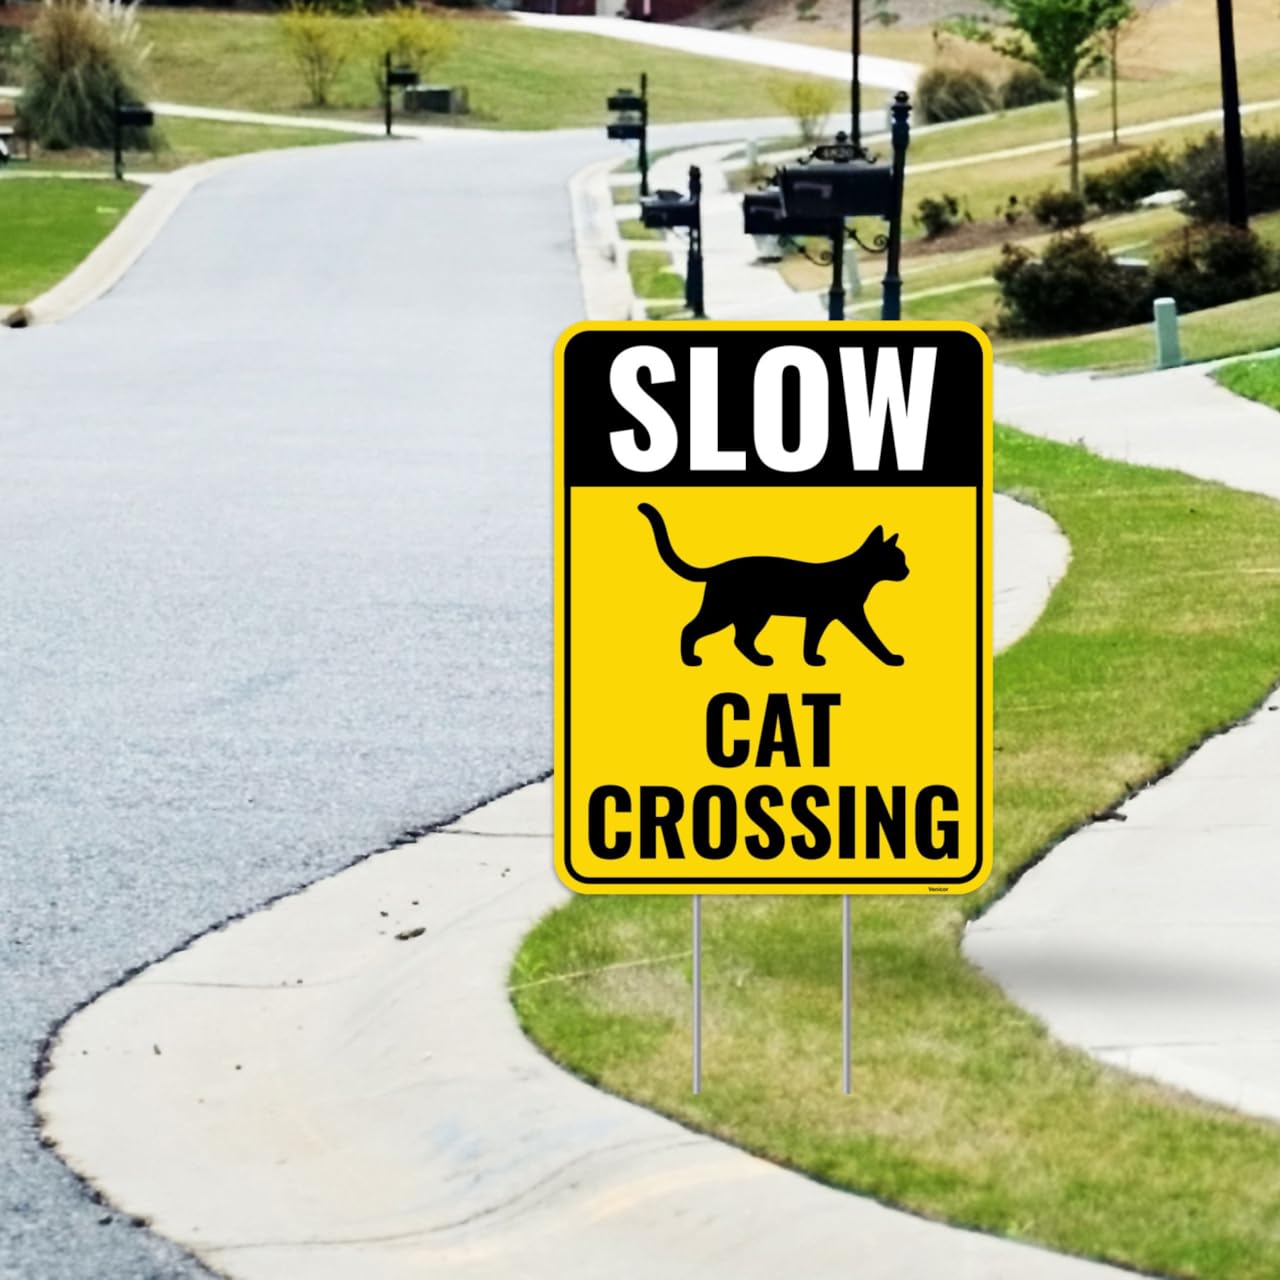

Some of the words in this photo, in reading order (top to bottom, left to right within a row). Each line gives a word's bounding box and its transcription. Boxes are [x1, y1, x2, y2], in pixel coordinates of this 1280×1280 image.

[610, 345, 938, 473] SLOW
[705, 691, 842, 769] CAT
[587, 784, 960, 861] CROSSING
